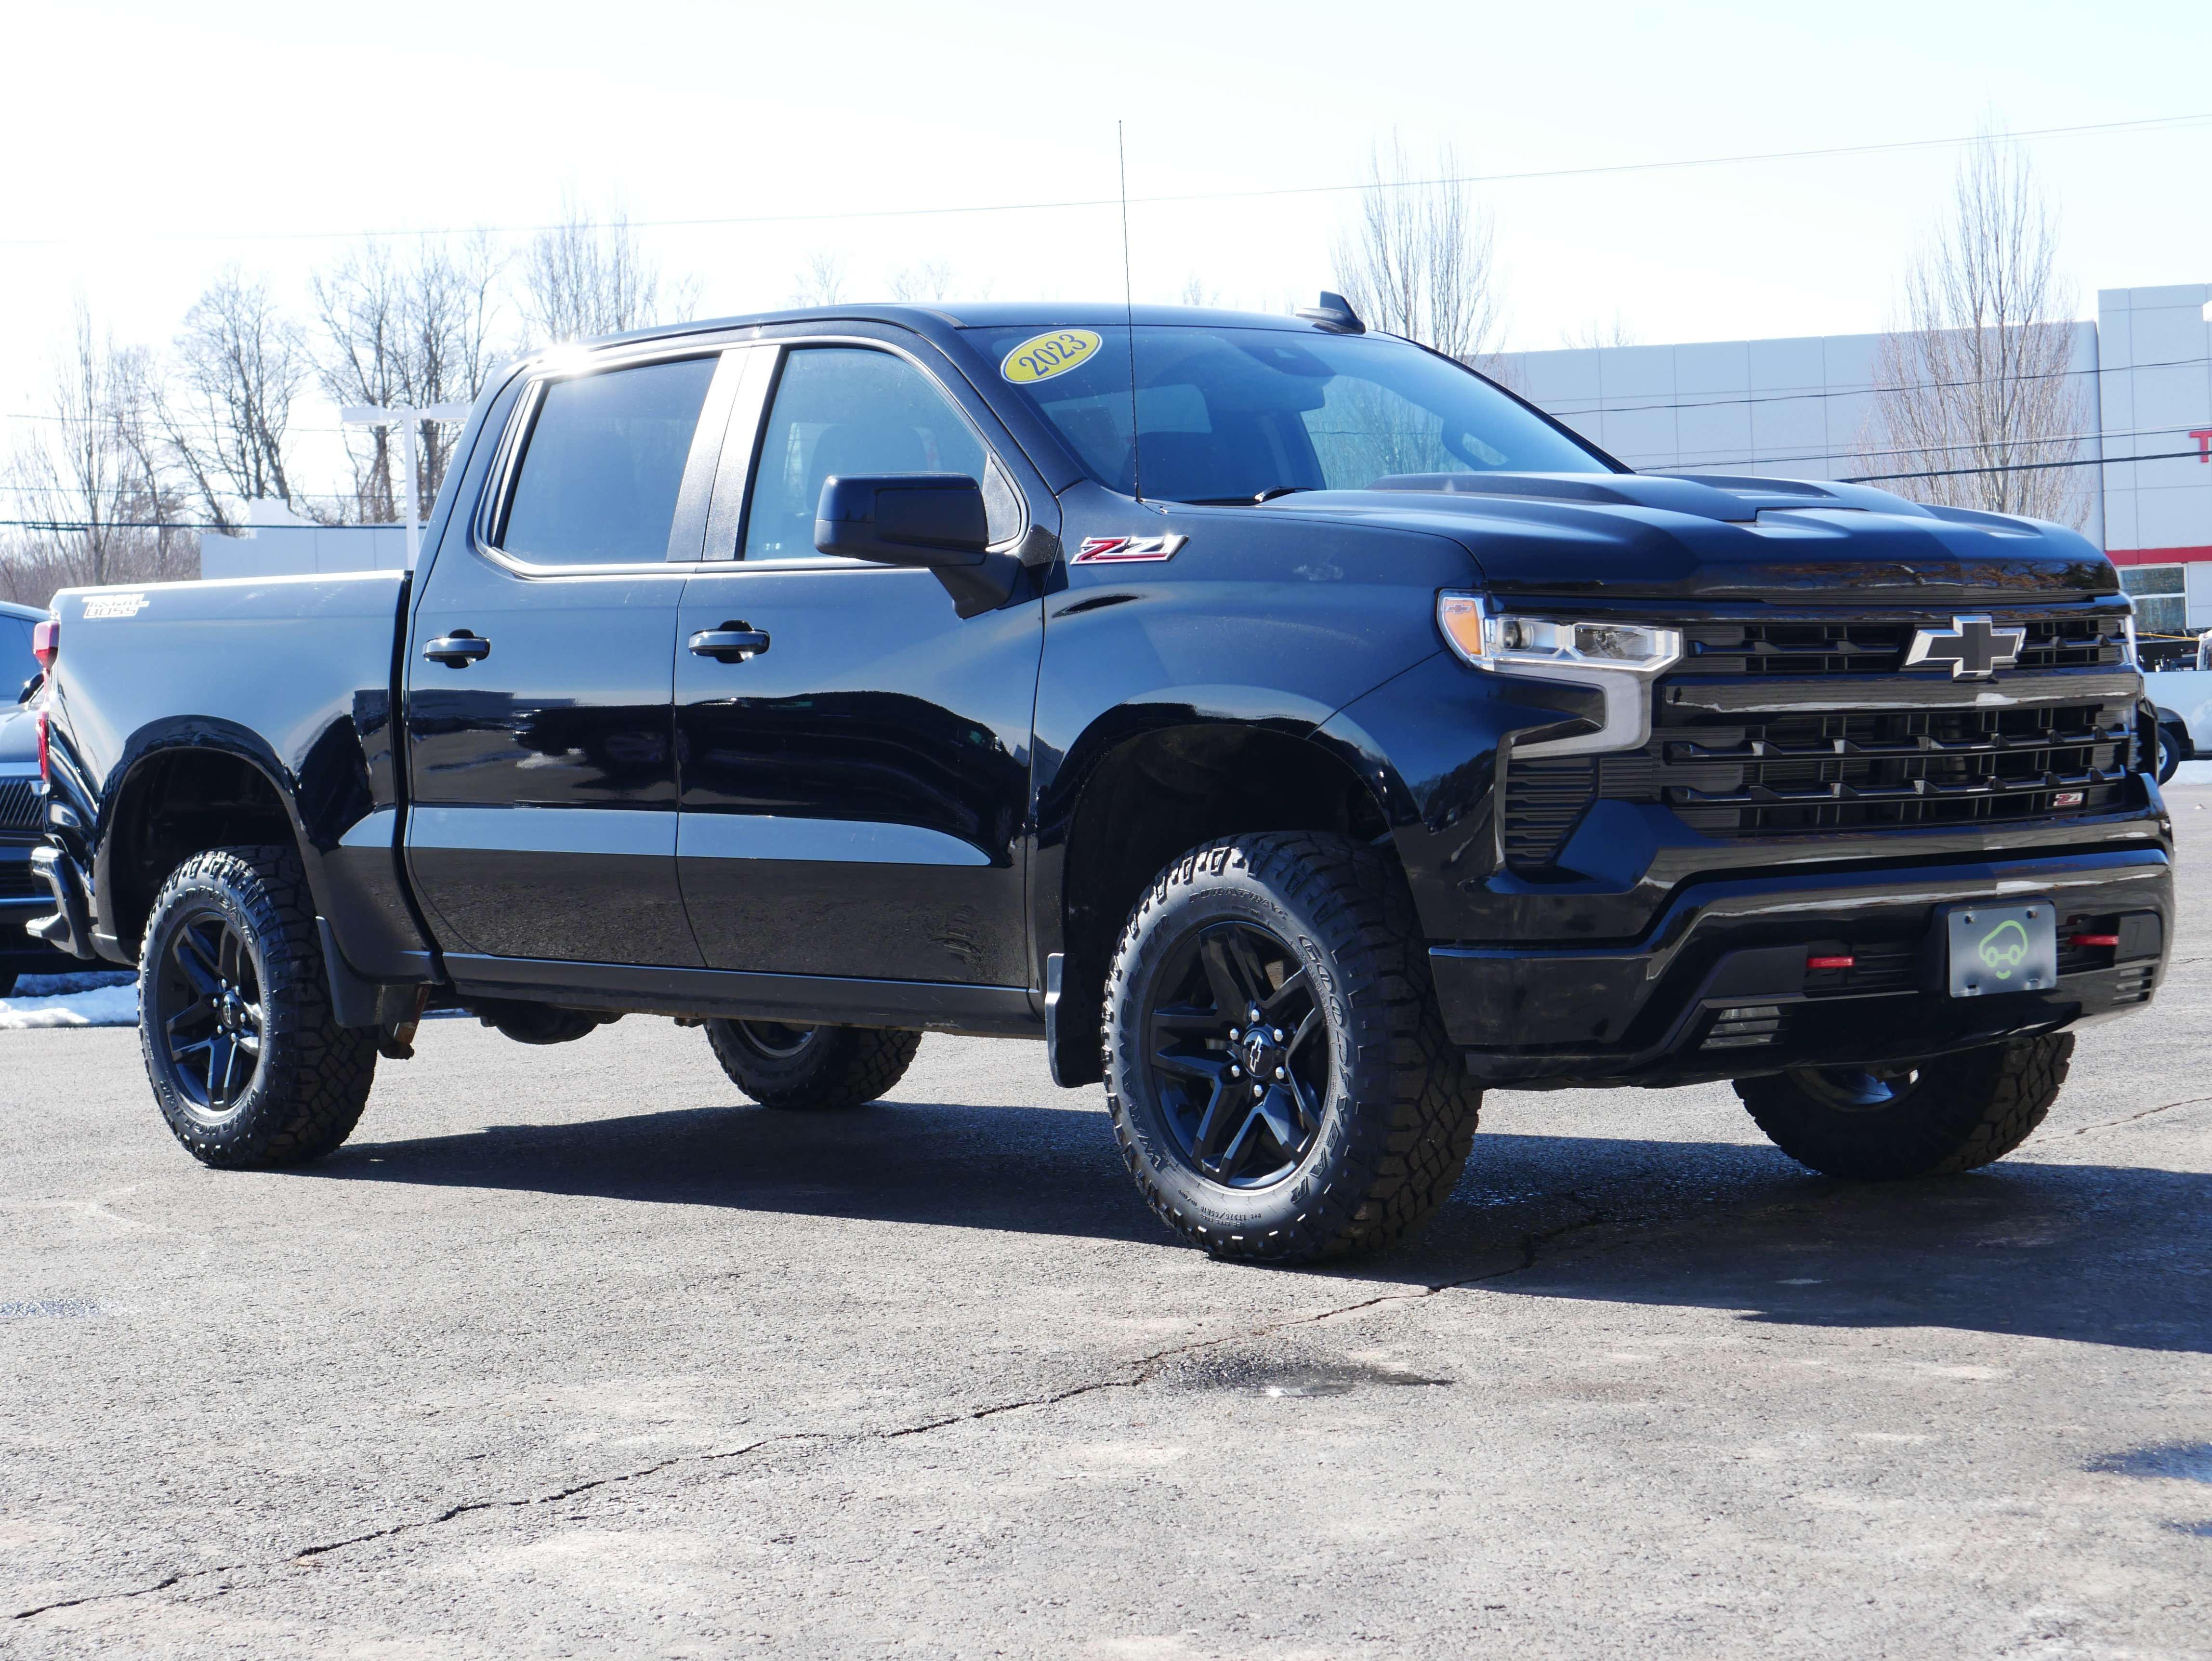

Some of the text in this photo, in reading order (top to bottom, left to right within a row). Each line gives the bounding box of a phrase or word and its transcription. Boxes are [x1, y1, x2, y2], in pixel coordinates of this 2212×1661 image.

[1019, 334, 1087, 376] 2023
[1069, 534, 1189, 566] Z71
[84, 606, 139, 619] BOSS
[2053, 792, 2084, 806] Z71
[1188, 887, 1289, 920] DURATRAC
[1290, 934, 1350, 1204] GOODYEAR
